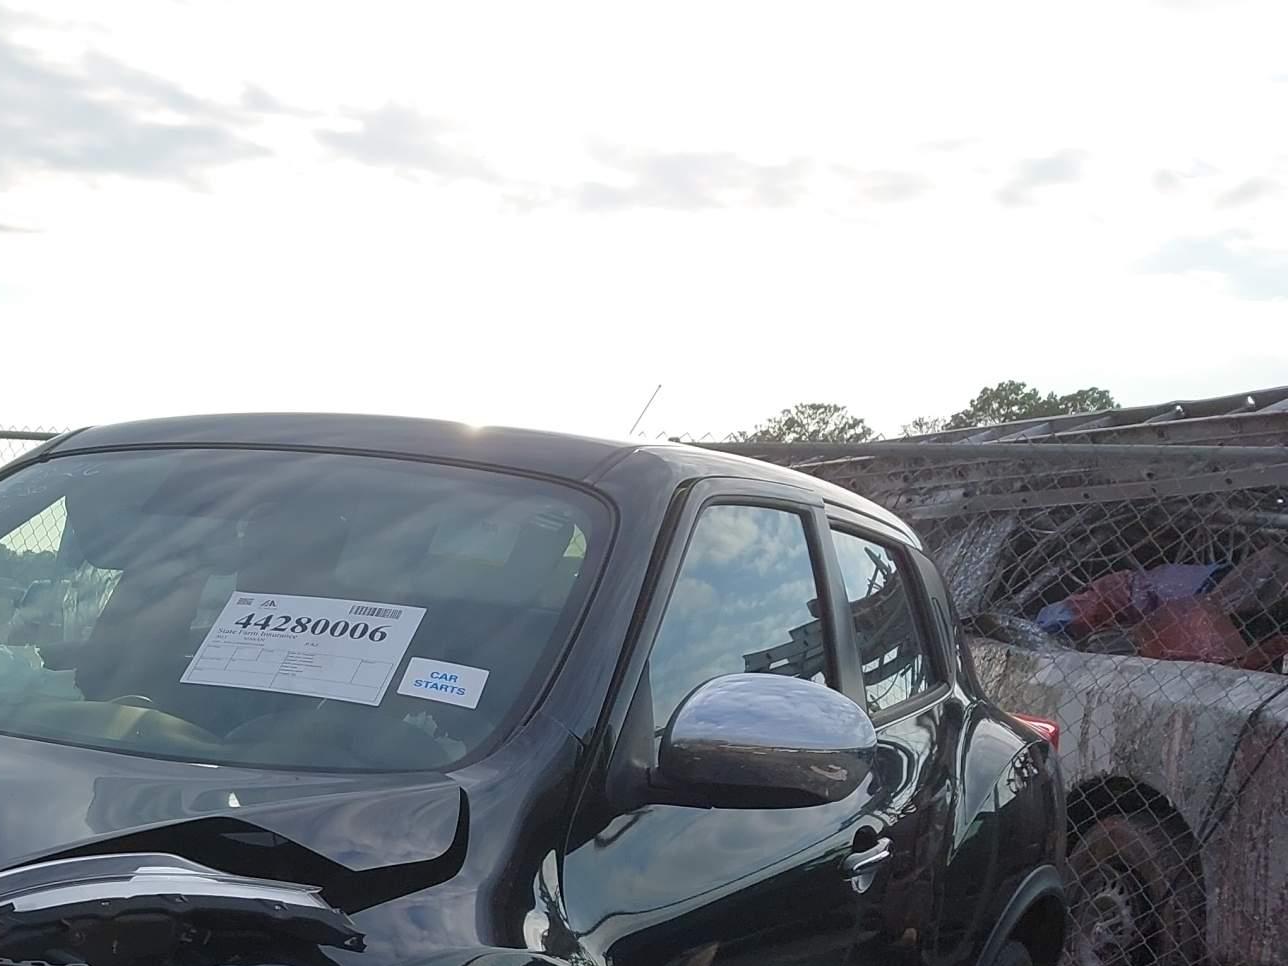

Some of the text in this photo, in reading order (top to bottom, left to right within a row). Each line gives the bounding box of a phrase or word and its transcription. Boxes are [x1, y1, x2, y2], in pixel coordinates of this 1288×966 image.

[234, 612, 392, 642] 44280006
[430, 671, 459, 683] CAR
[414, 679, 467, 696] STARTS
